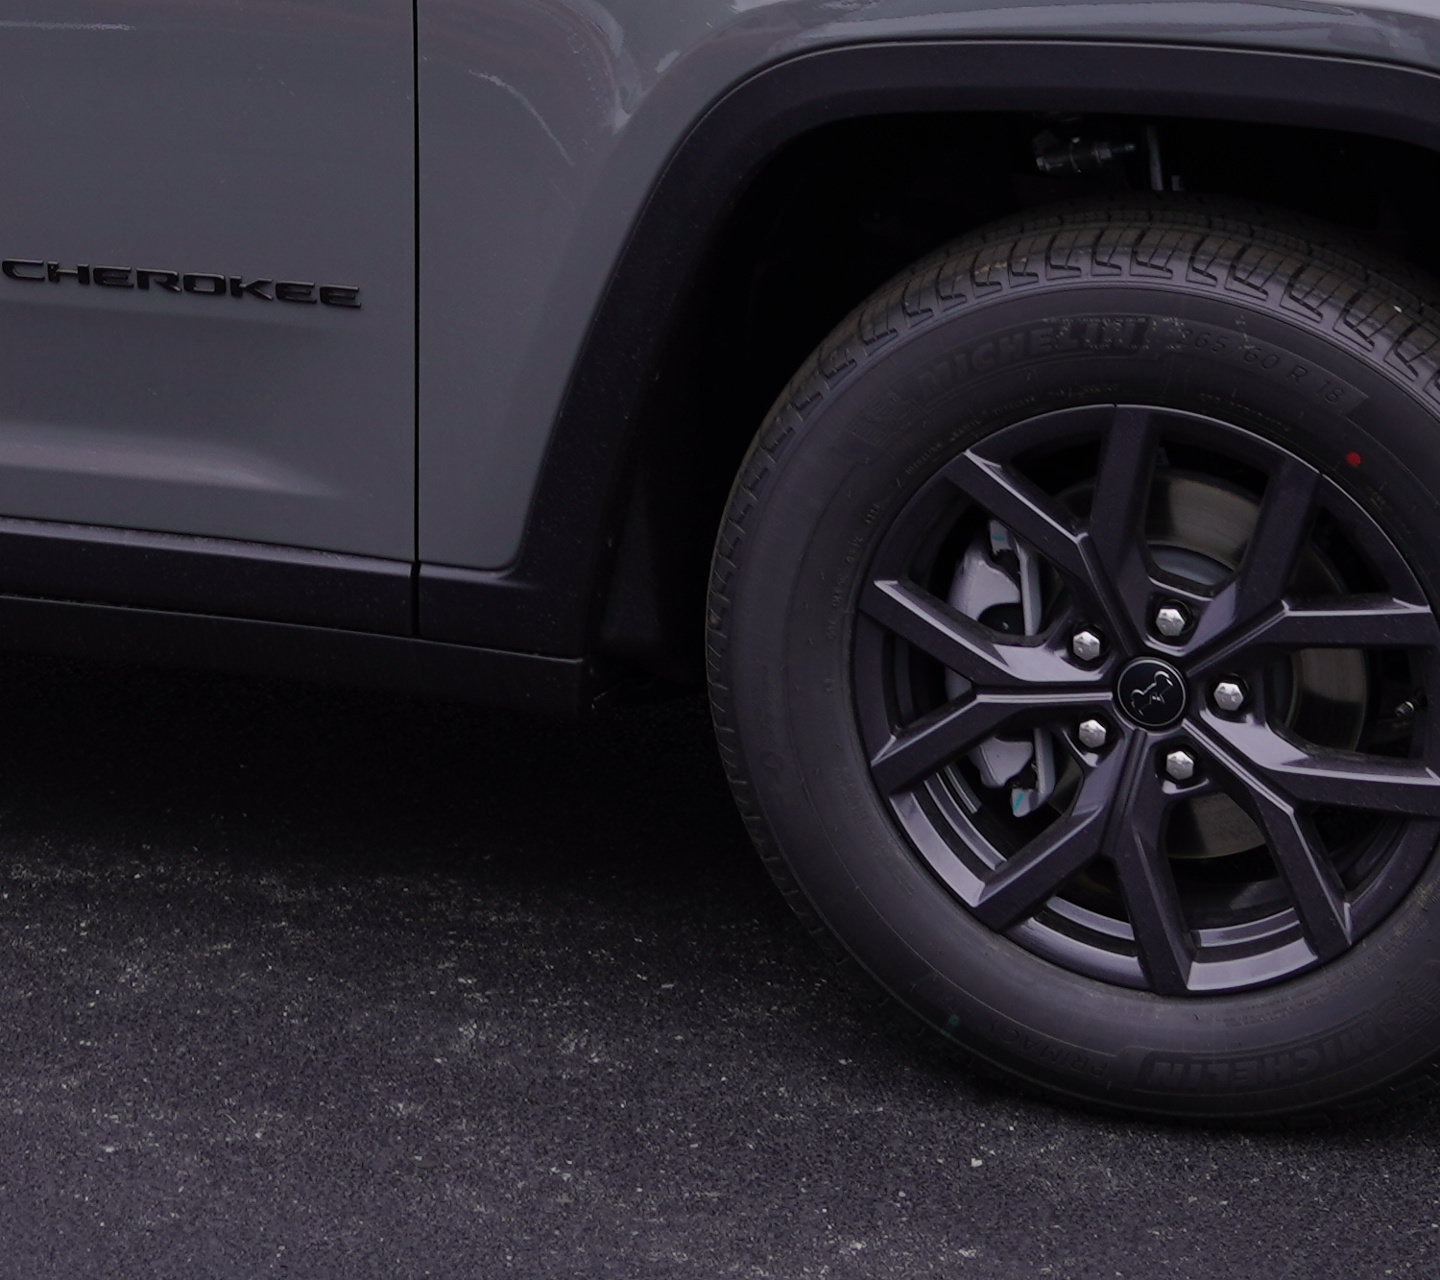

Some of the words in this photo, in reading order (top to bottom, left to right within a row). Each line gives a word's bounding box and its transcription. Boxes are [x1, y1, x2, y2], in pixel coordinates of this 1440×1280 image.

[1, 258, 363, 310] CHEROKEE
[916, 317, 1150, 397] MICHELIN
[1151, 1019, 1371, 1091] MICHELIN
